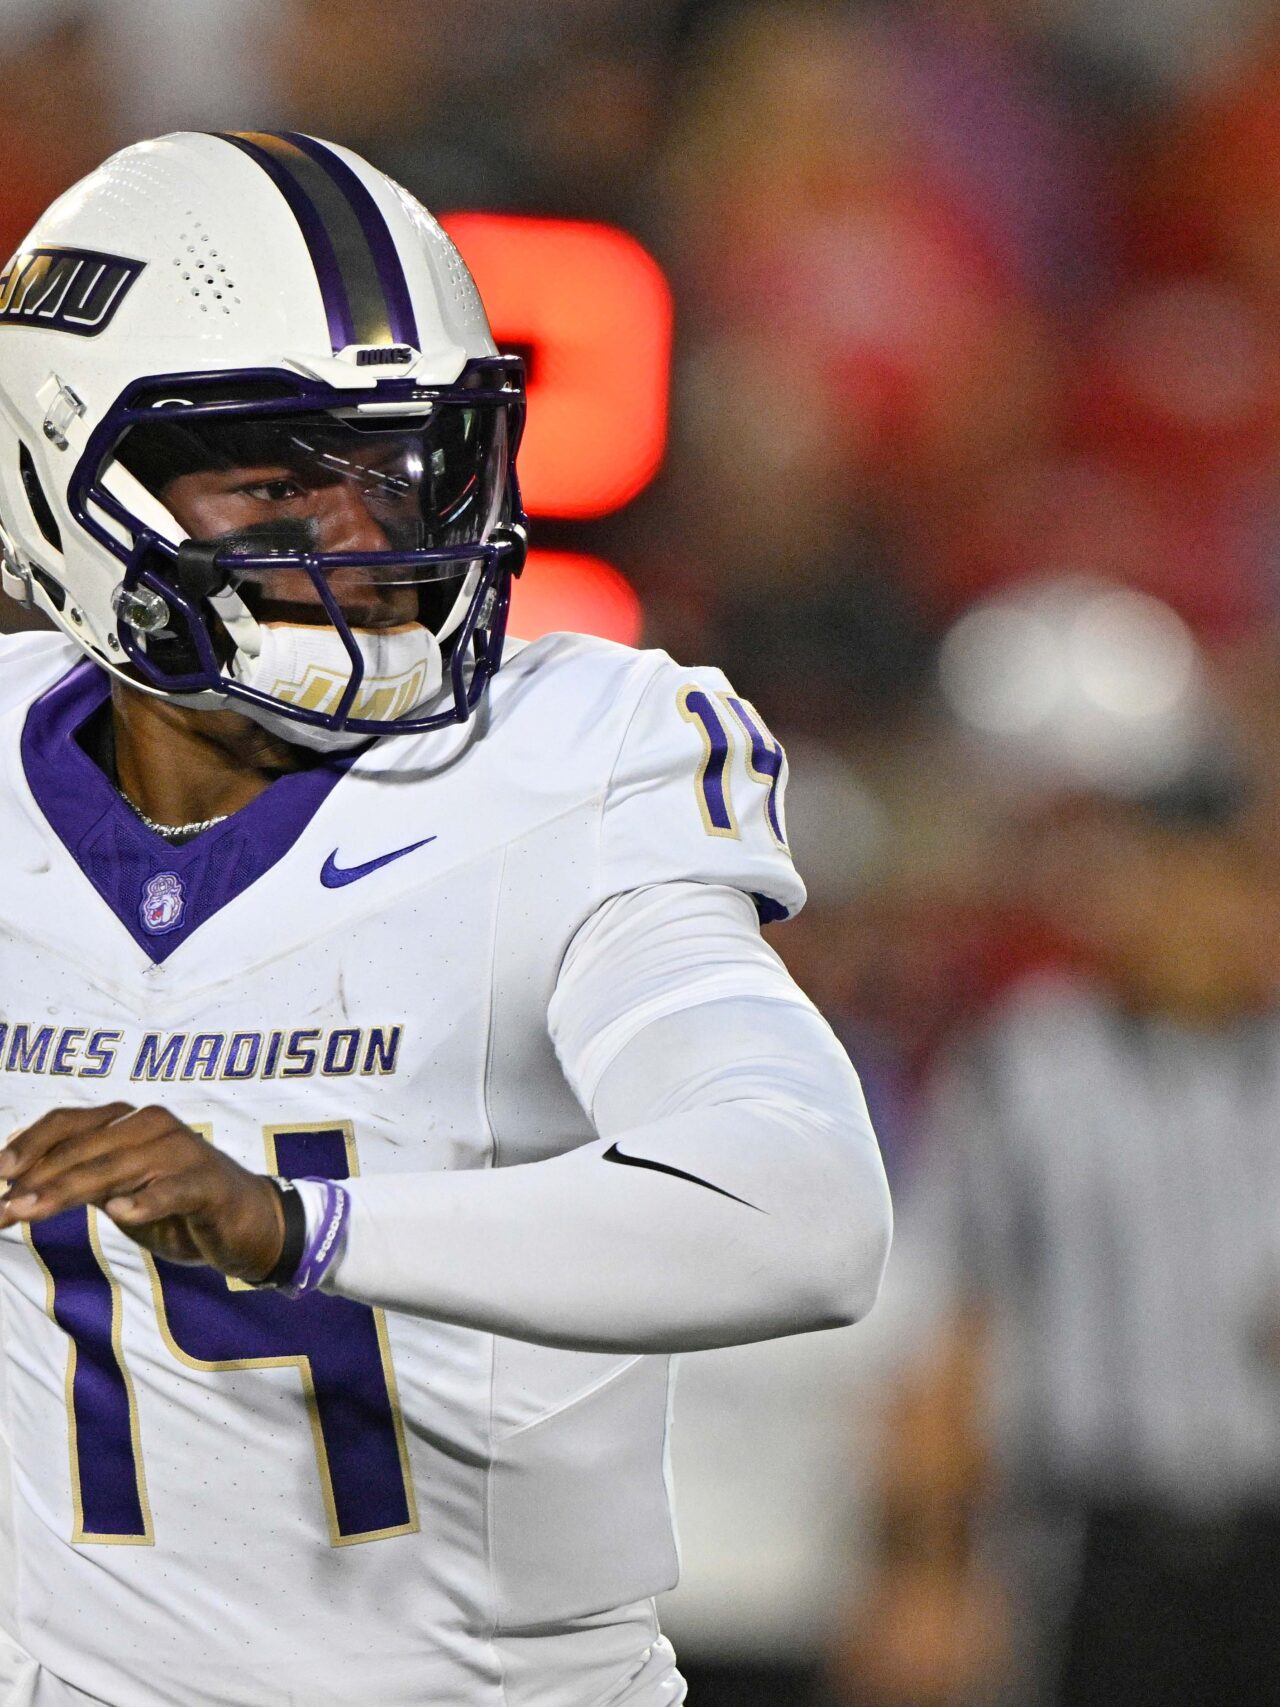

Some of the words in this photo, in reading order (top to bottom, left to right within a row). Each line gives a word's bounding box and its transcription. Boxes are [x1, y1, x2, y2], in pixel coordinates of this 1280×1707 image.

[356, 348, 412, 367] DUKES
[676, 683, 791, 858] 14
[130, 1024, 404, 1081] MADISON
